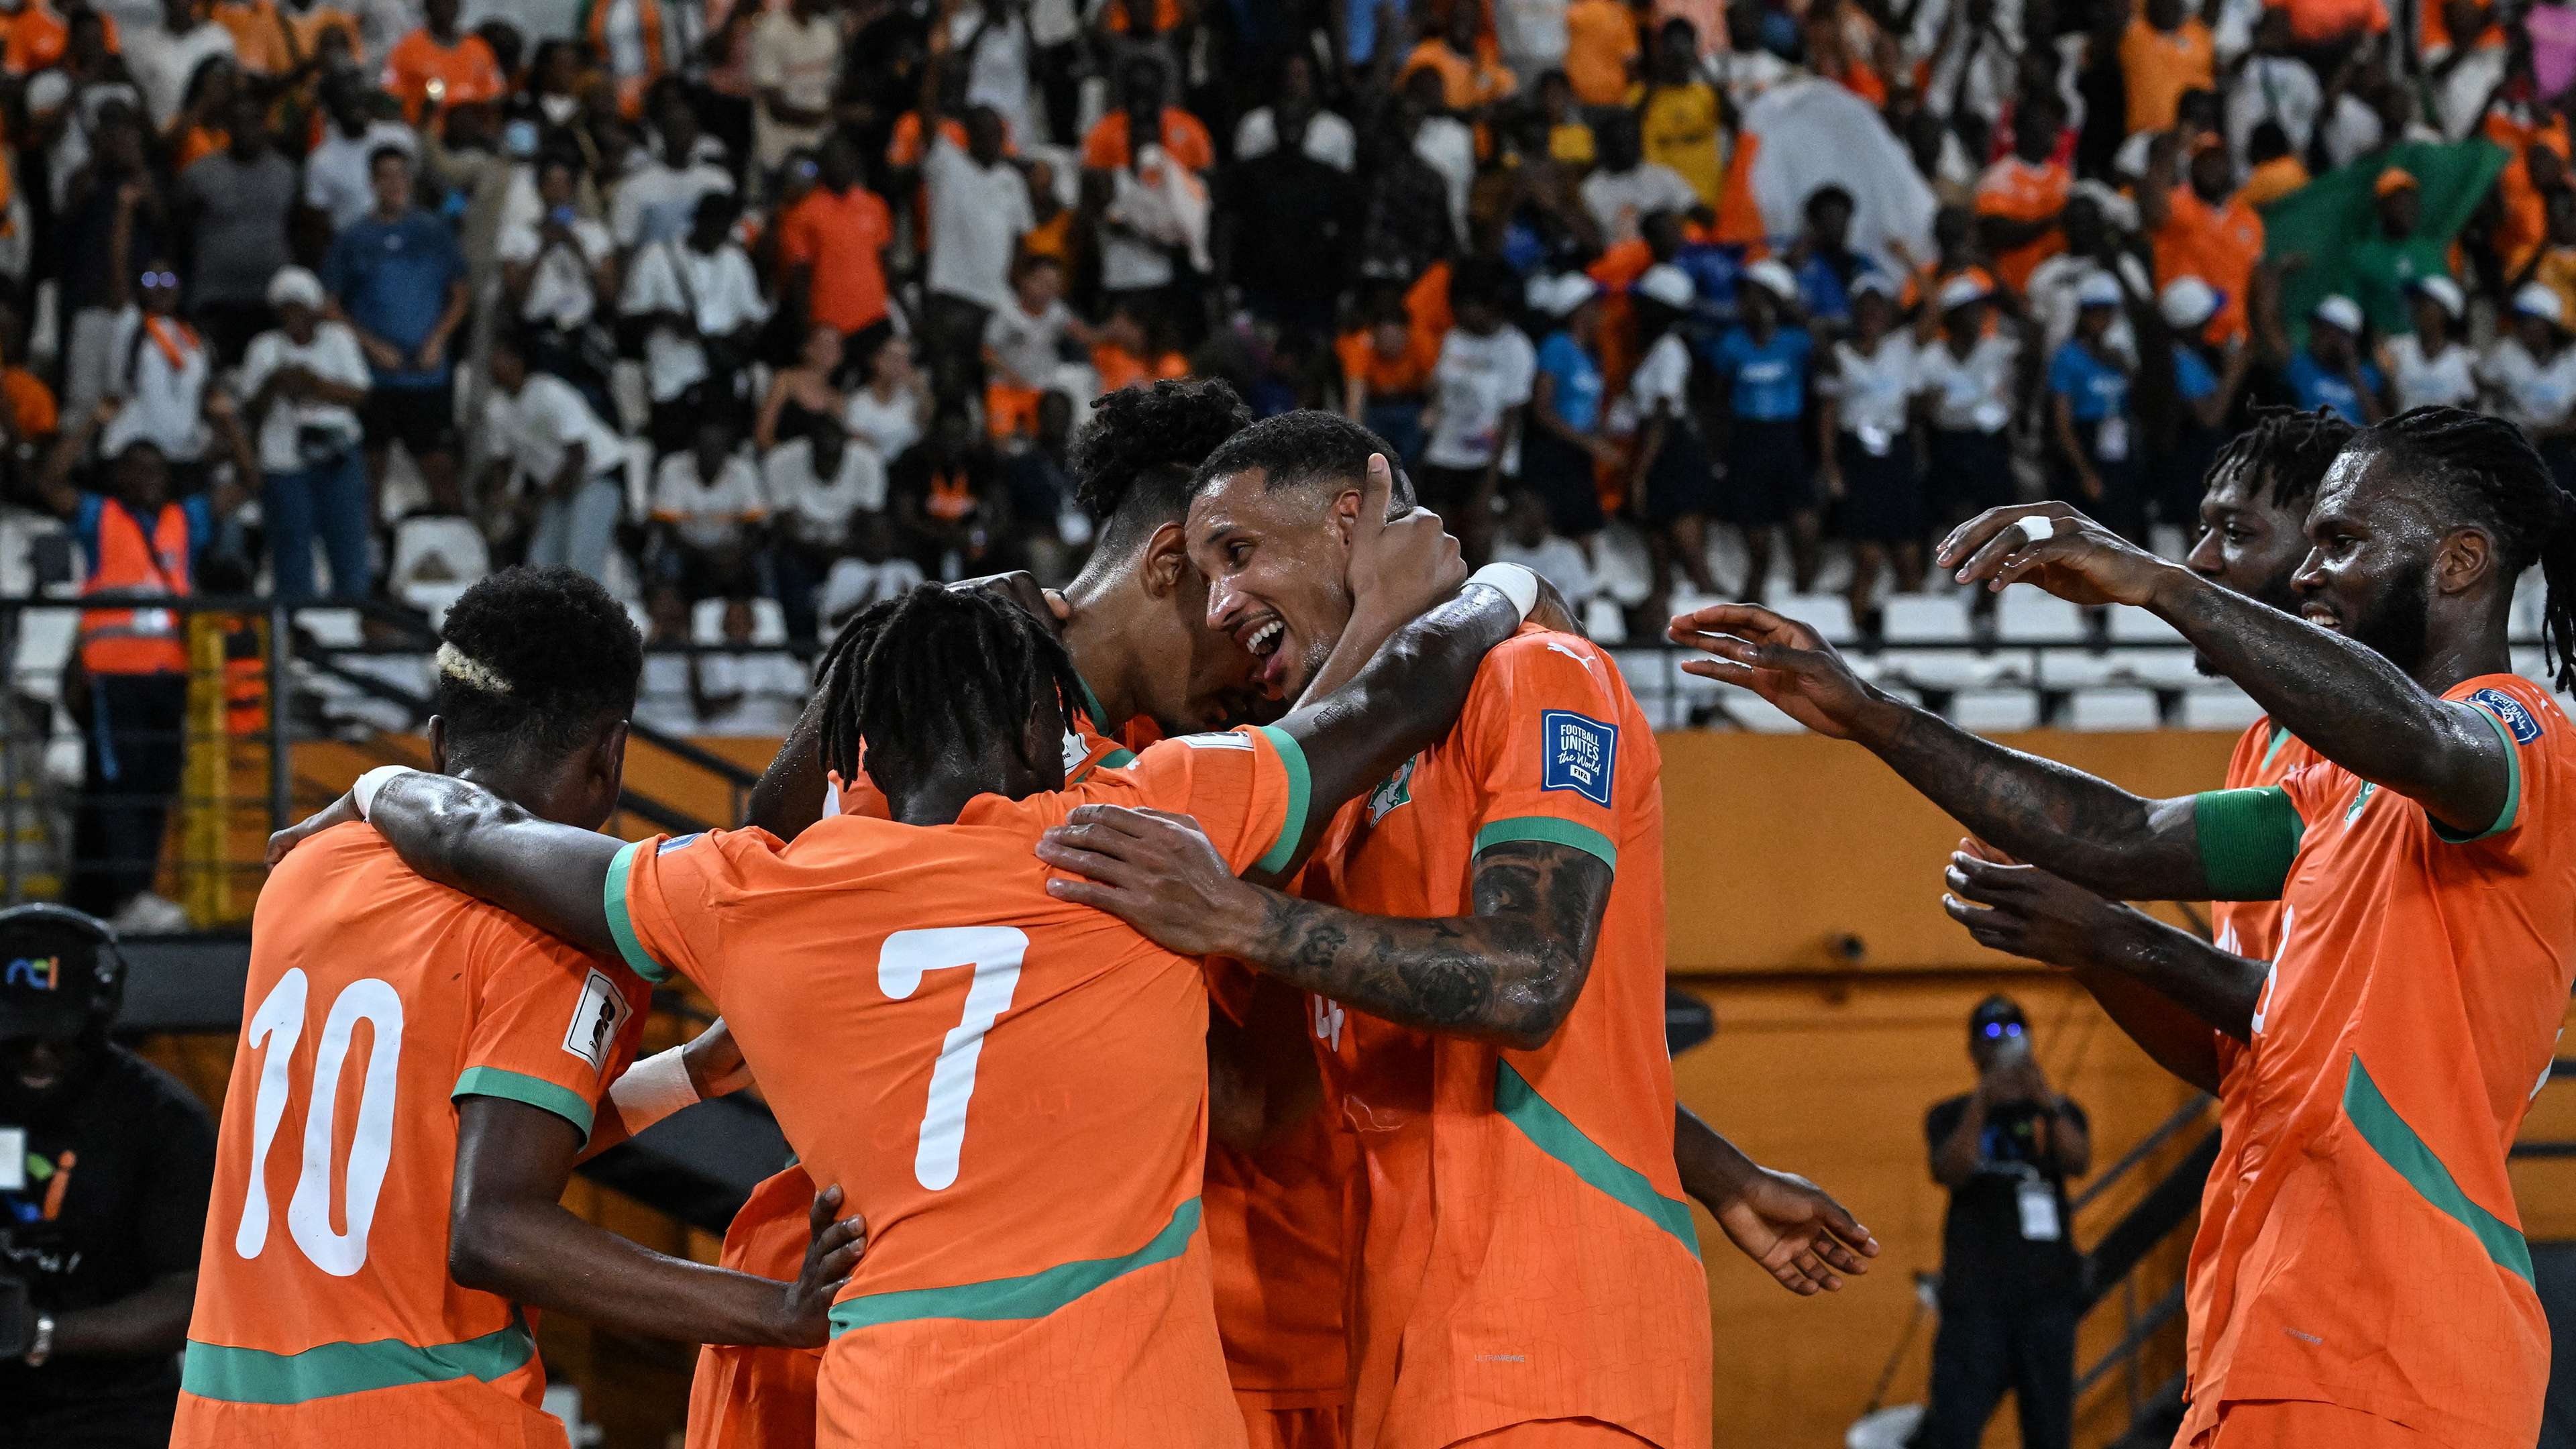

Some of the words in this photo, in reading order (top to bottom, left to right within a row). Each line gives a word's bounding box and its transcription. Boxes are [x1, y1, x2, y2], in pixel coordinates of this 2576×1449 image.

[1560, 724, 1600, 747] FOOTBALL
[1560, 735, 1600, 761] UNITES
[1557, 750, 1576, 764] the
[1576, 751, 1601, 776] World
[1574, 768, 1589, 781] FIFA
[877, 926, 1030, 1191] 7
[235, 967, 404, 1277] 10
